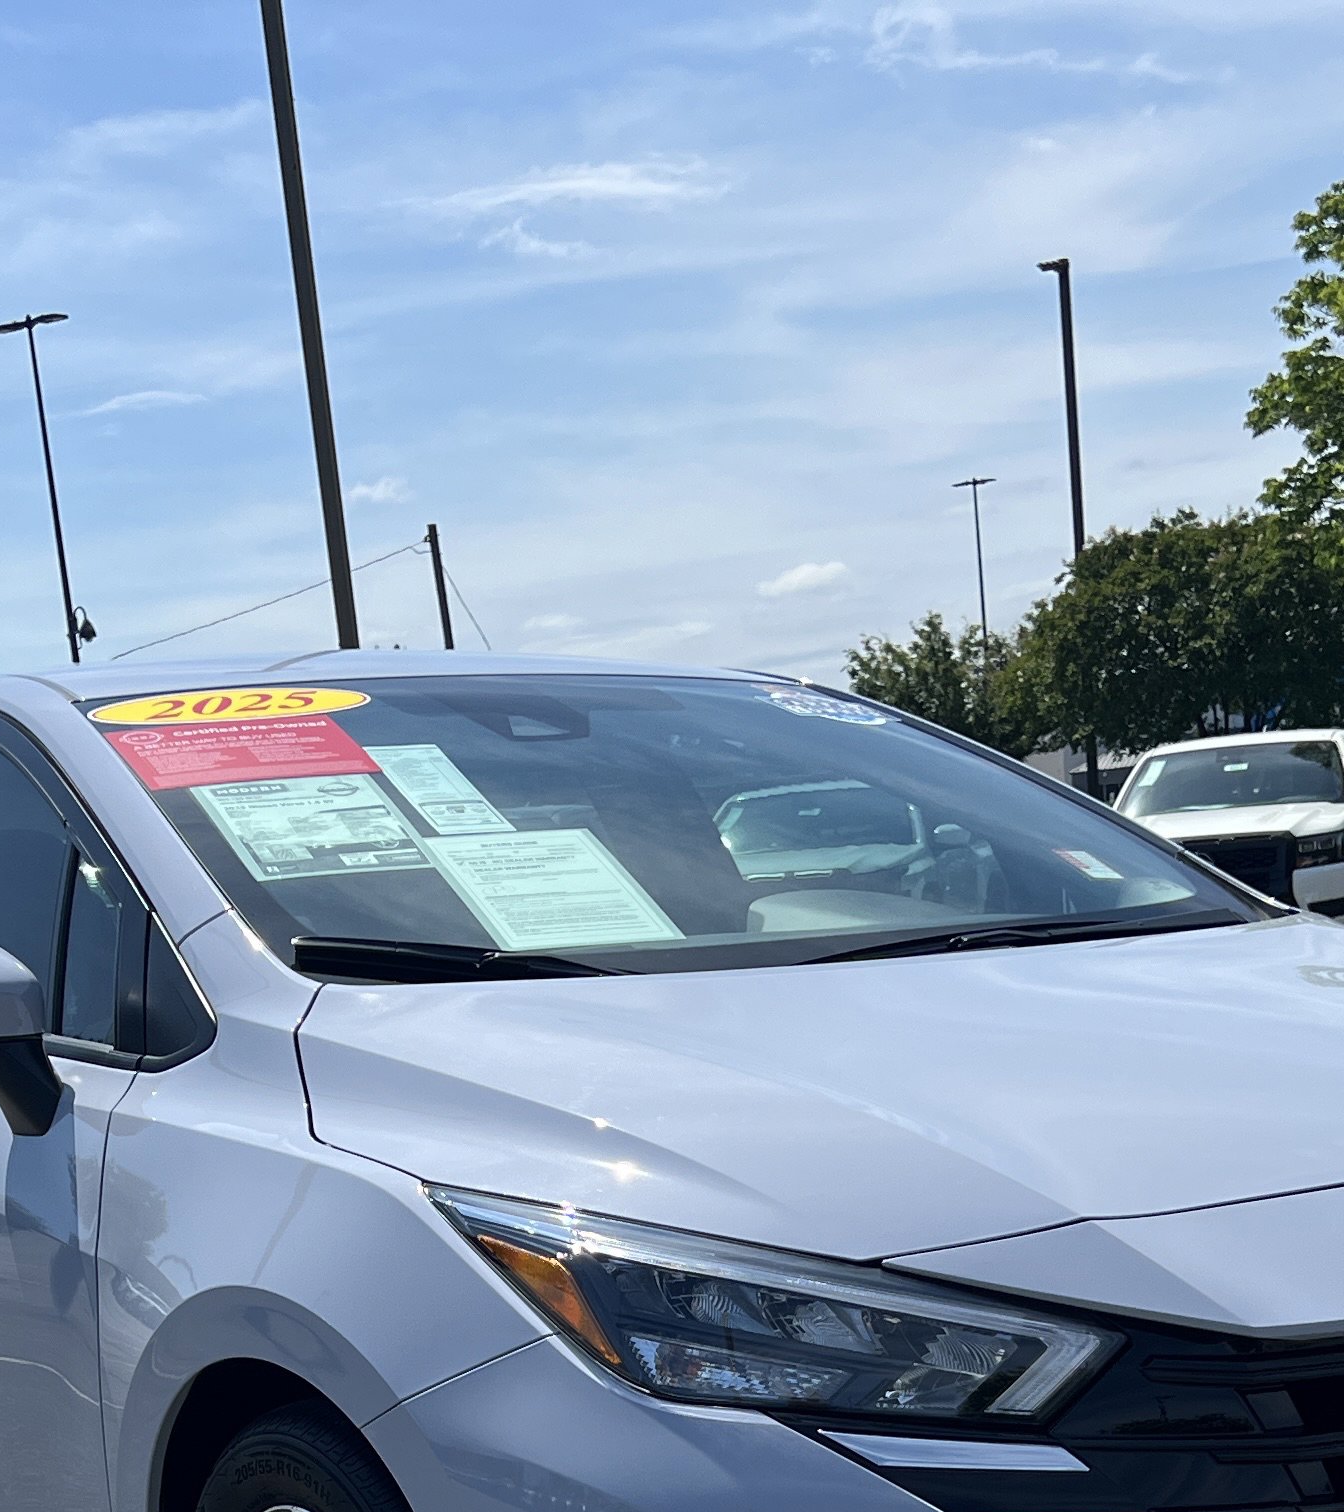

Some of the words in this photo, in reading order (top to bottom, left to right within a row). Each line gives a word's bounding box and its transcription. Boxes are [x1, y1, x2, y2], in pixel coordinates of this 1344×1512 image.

[145, 691, 317, 720] 2025
[172, 725, 239, 737] Certified
[241, 719, 327, 731] Pre-Owned
[216, 784, 283, 796] MODERN
[234, 1459, 273, 1484] 205/55
